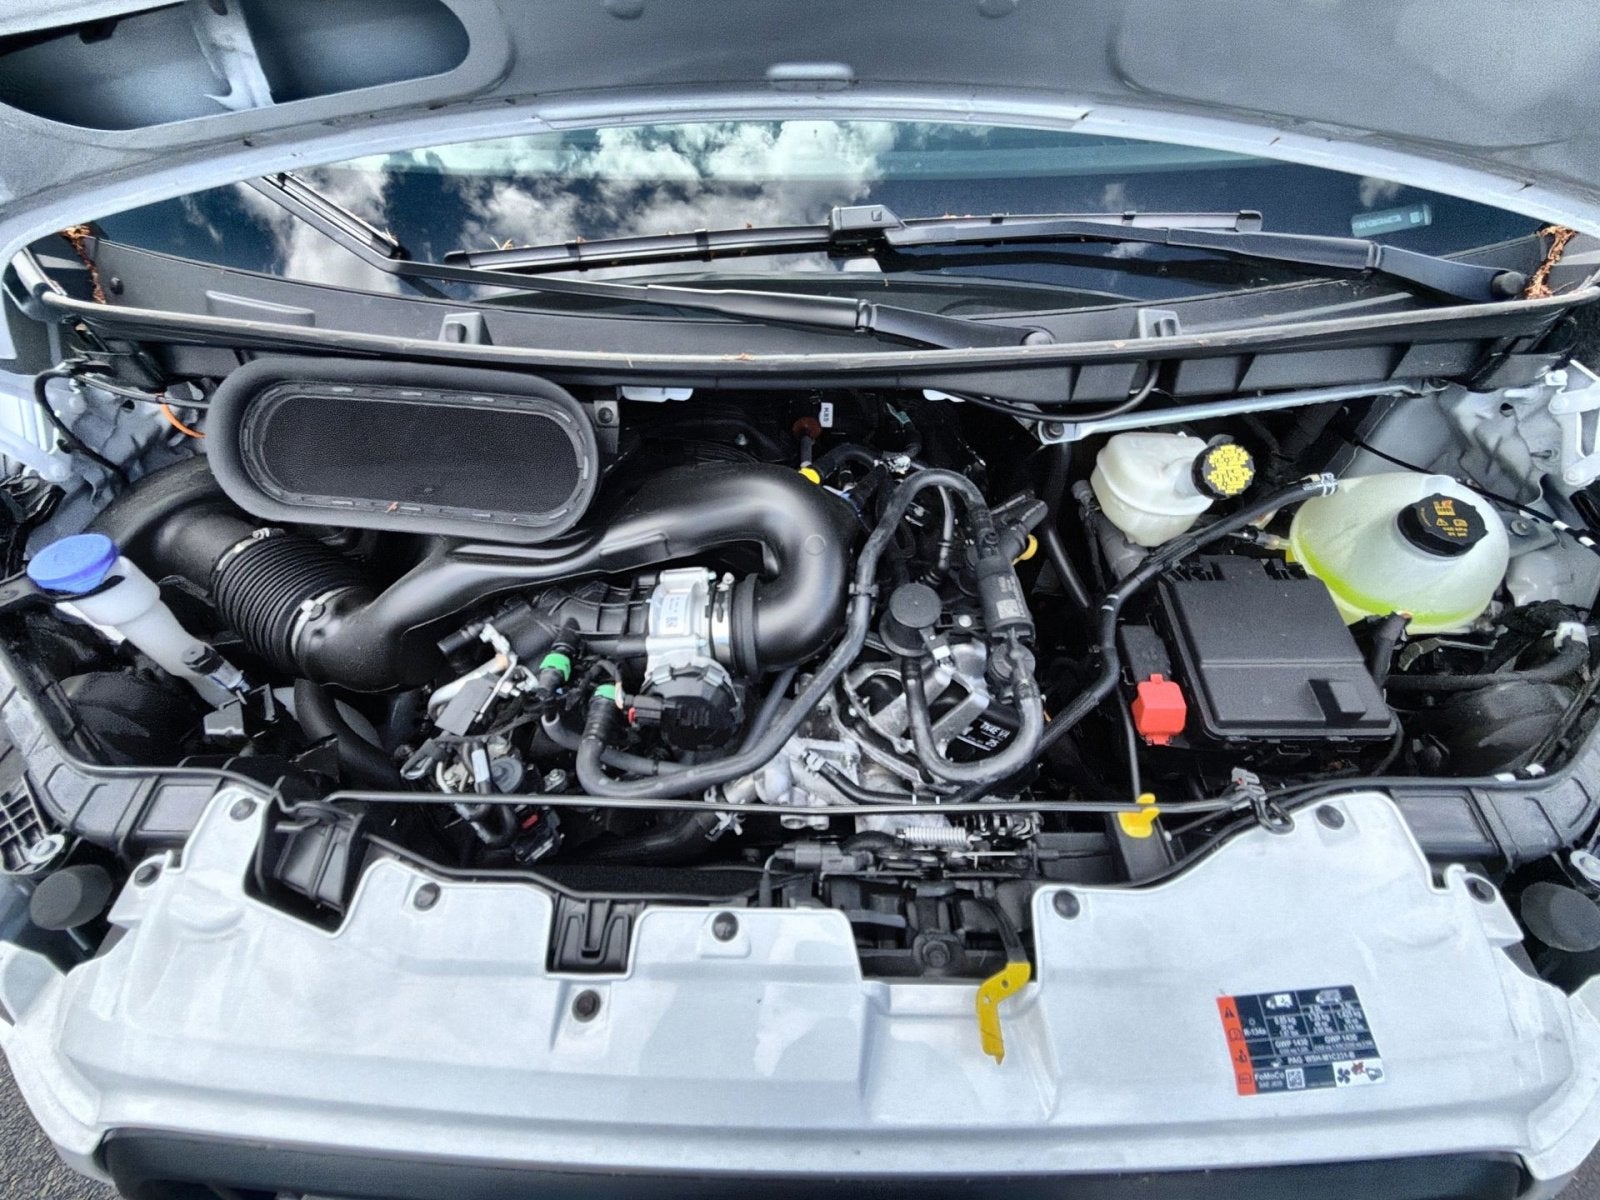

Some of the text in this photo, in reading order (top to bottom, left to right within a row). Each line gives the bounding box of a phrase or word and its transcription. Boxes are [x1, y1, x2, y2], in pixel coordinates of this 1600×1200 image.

[1275, 1040, 1291, 1048] GWP
[1324, 1035, 1340, 1044] GWP
[1254, 1071, 1285, 1082] FoMoCo
